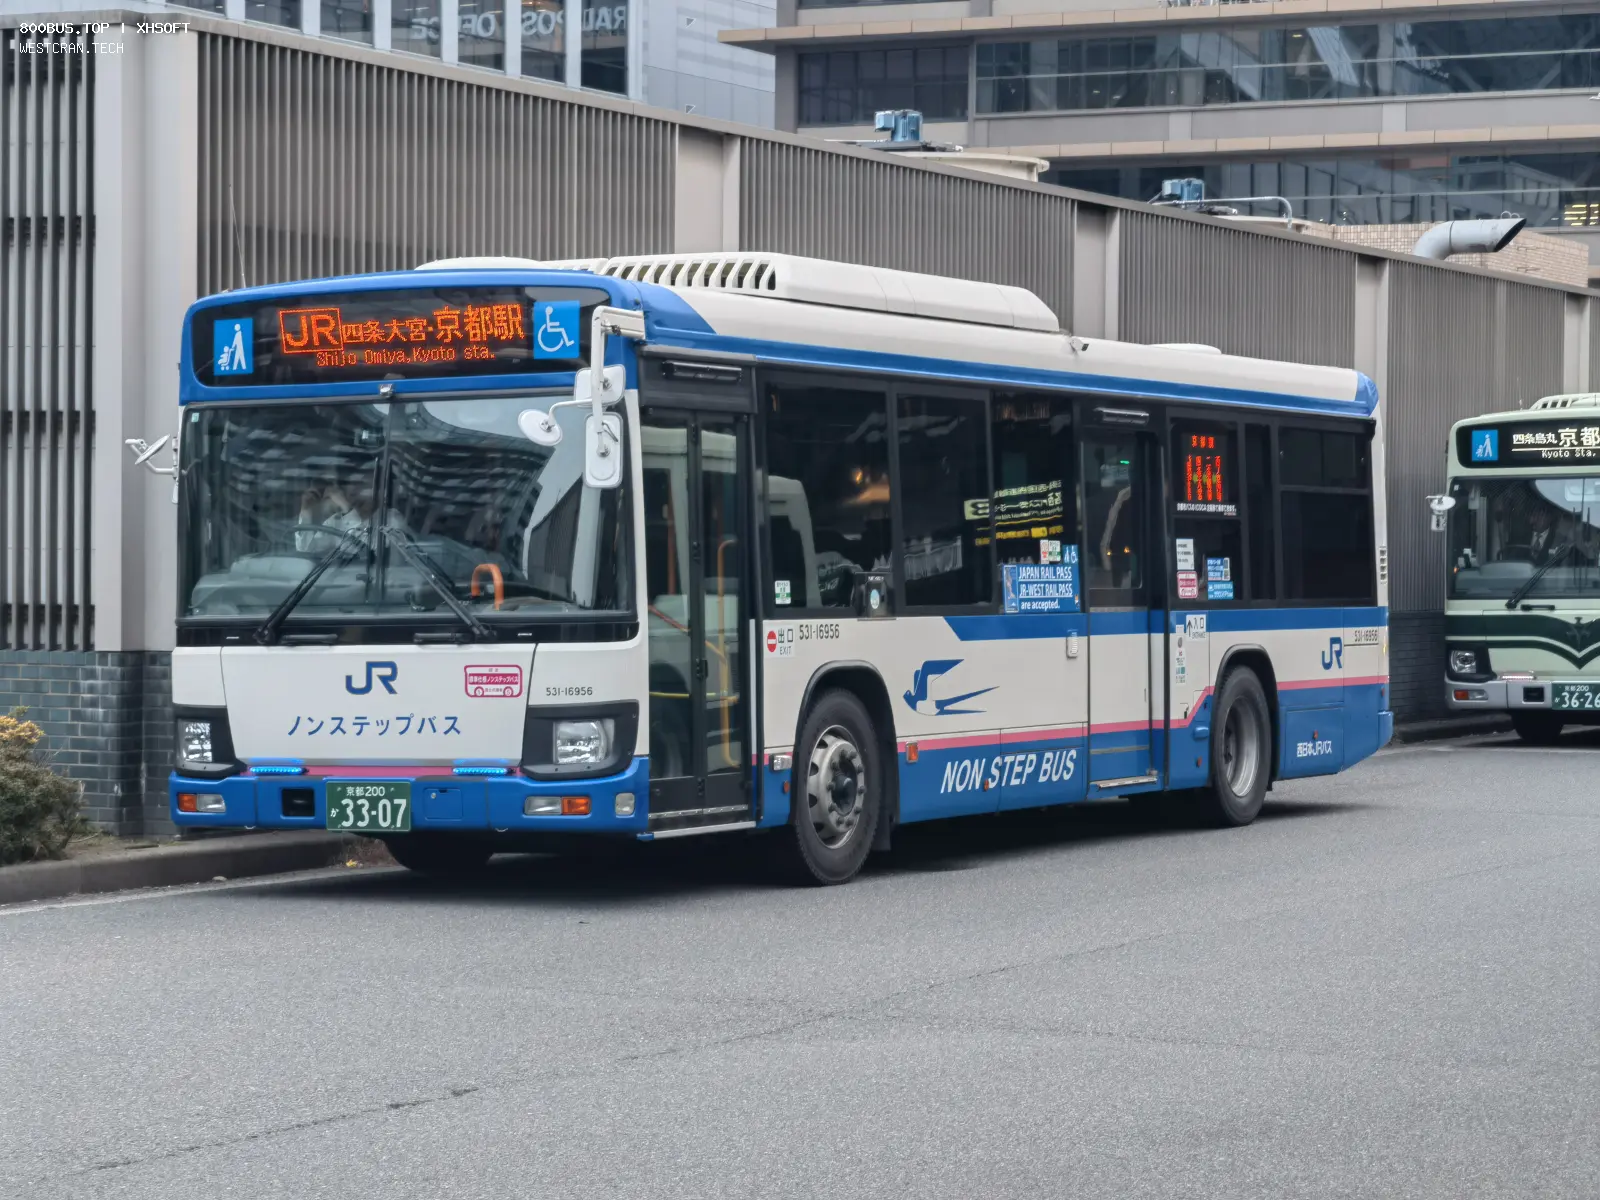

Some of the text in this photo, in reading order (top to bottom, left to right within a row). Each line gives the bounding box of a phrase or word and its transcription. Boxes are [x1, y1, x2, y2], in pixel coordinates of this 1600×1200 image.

[285, 314, 340, 347] JR
[316, 351, 357, 367] Shijo
[464, 345, 495, 360] sta.
[1541, 449, 1570, 458] Kyoto
[1019, 566, 1073, 580] JAPAN RAIL PASS
[1020, 583, 1073, 597] JR-WEST RAIL PASS
[1021, 599, 1060, 612] are accepted.
[1193, 617, 1205, 630] 入口
[778, 628, 794, 643] 出口
[799, 624, 840, 640] 531-16956
[779, 645, 792, 655] EXIT
[1321, 636, 1343, 670] JR
[345, 661, 399, 695] JR
[546, 686, 593, 696] 531-16956
[287, 713, 461, 736] ノンステップバス
[1296, 740, 1333, 758] 西日本JRバス
[940, 749, 1077, 794] NON STEP BUS
[346, 786, 385, 797] 京都200
[341, 798, 407, 828] 33-07
